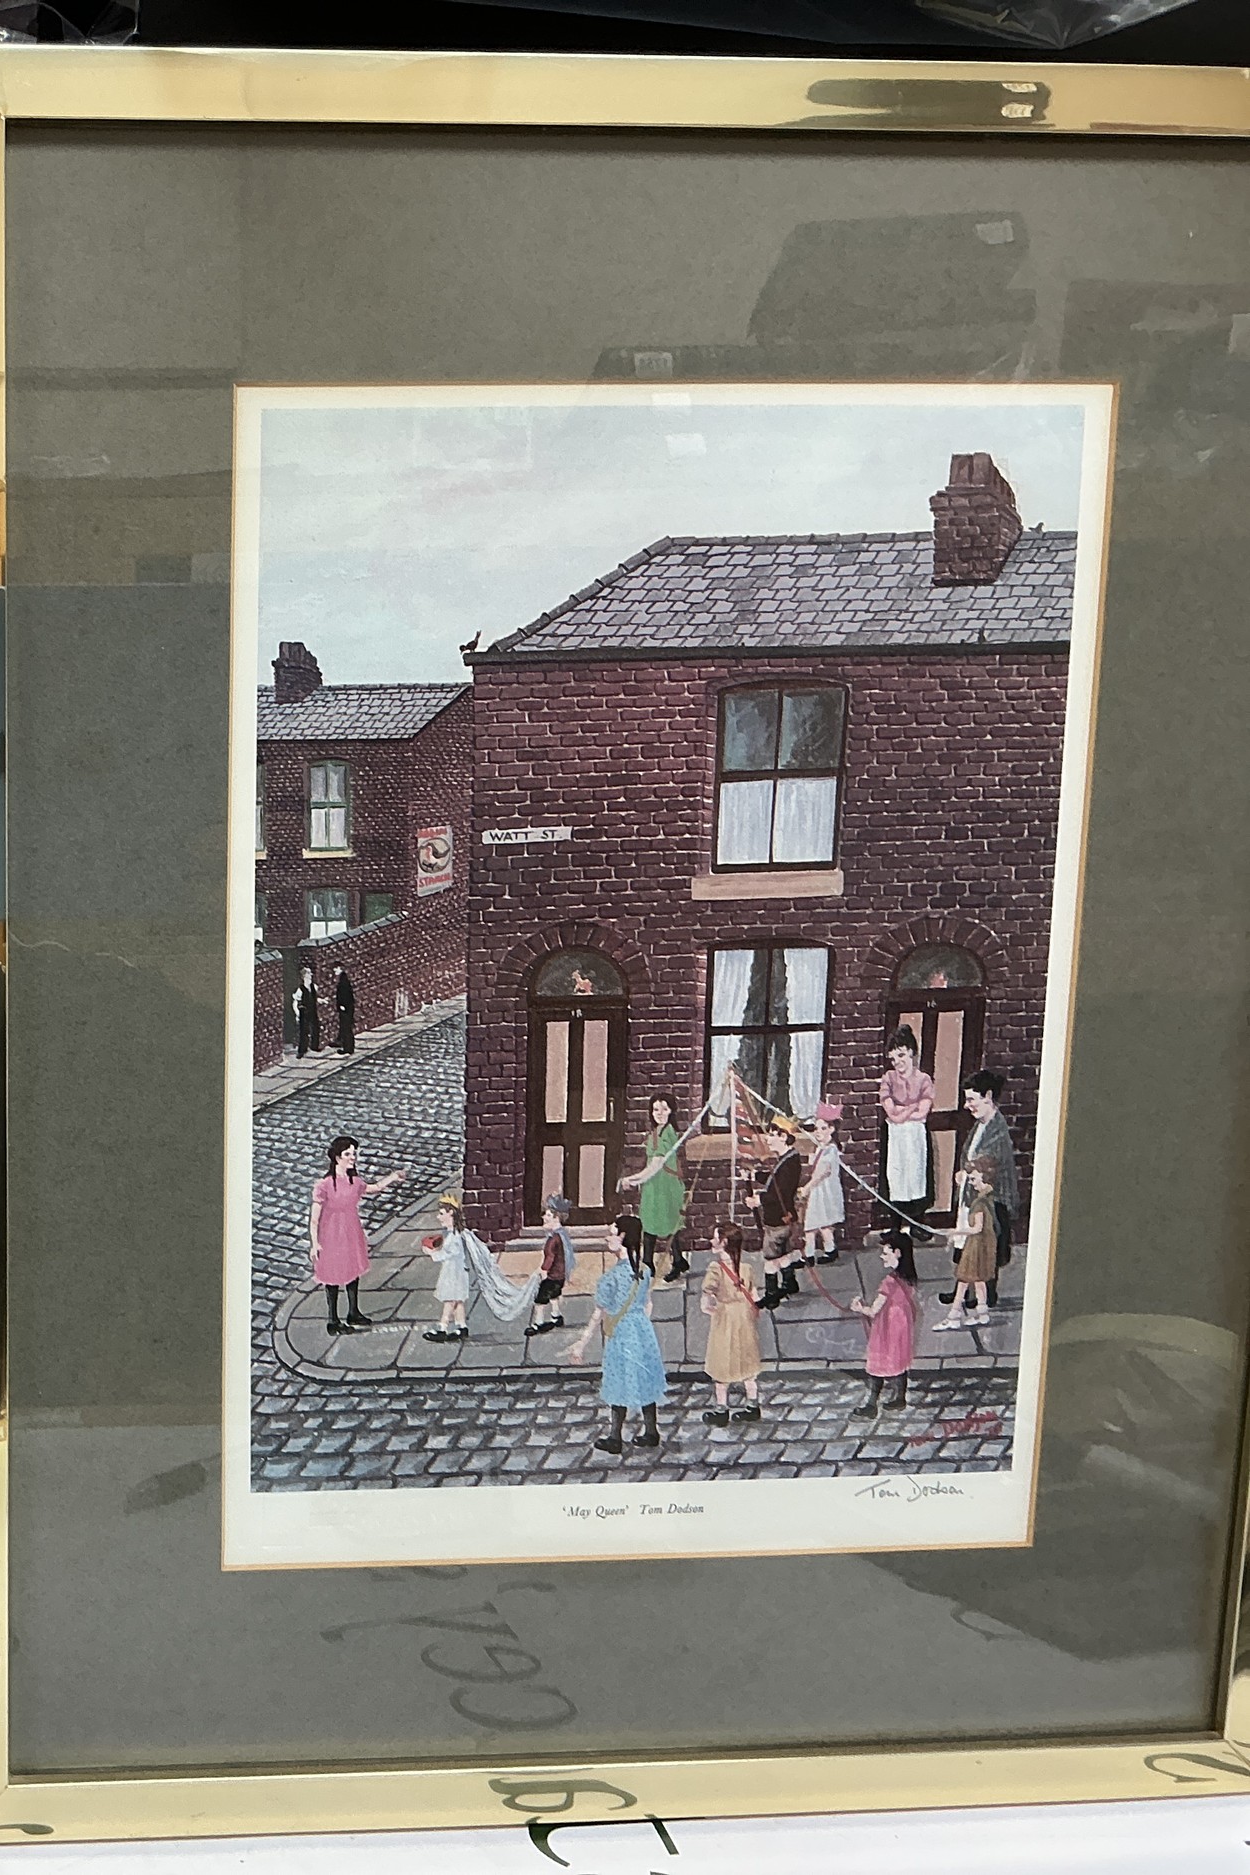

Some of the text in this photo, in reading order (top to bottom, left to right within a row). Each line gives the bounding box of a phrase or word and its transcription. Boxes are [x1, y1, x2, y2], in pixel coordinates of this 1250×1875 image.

[489, 831, 534, 842] WATT
[854, 1478, 901, 1499] Tom
[639, 1503, 663, 1515] Tom
[667, 1502, 705, 1515] Dodson
